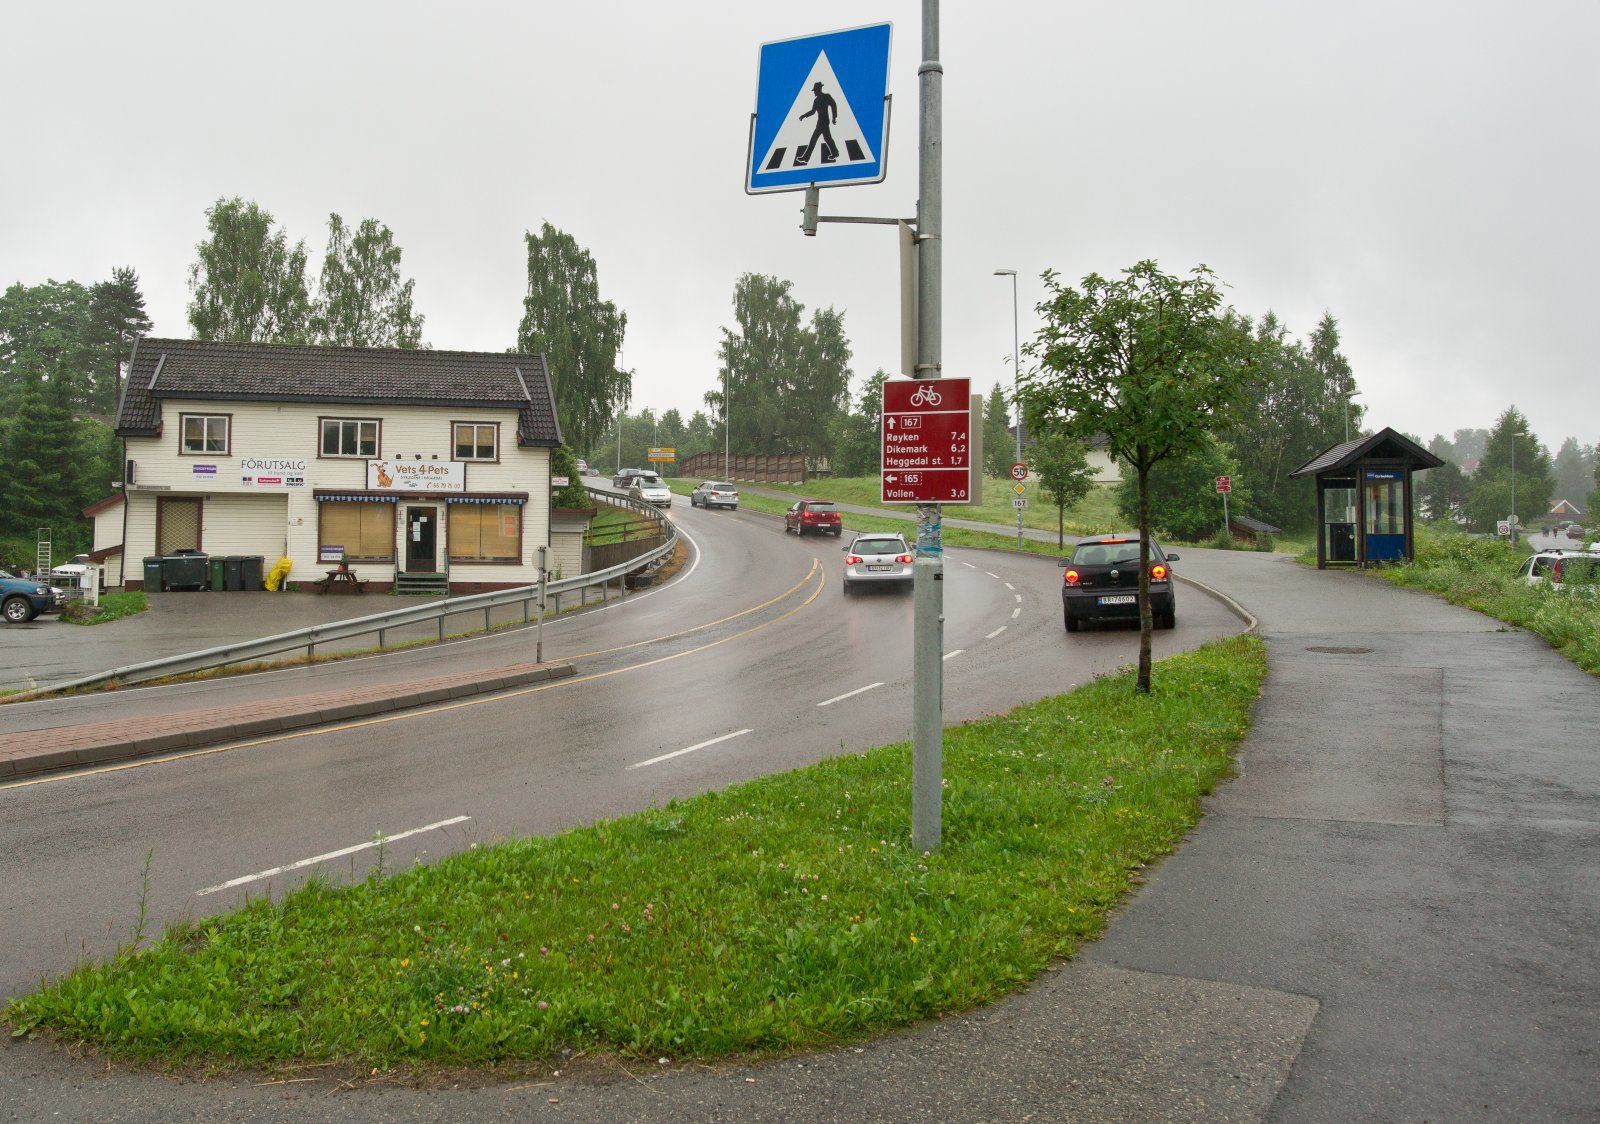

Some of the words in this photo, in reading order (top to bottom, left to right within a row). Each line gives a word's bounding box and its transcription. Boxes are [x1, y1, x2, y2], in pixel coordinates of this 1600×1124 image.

[903, 418, 918, 427] 167
[886, 433, 919, 443] Røyken
[886, 445, 928, 453] Dikemark
[886, 457, 929, 467] Heggedal
[932, 457, 943, 465] st.
[396, 465, 416, 474] Vets
[418, 464, 427, 475] 4
[428, 466, 449, 475] Pets
[1013, 467, 1025, 477] 50
[904, 474, 918, 483] 165
[886, 489, 914, 498] Vollen
